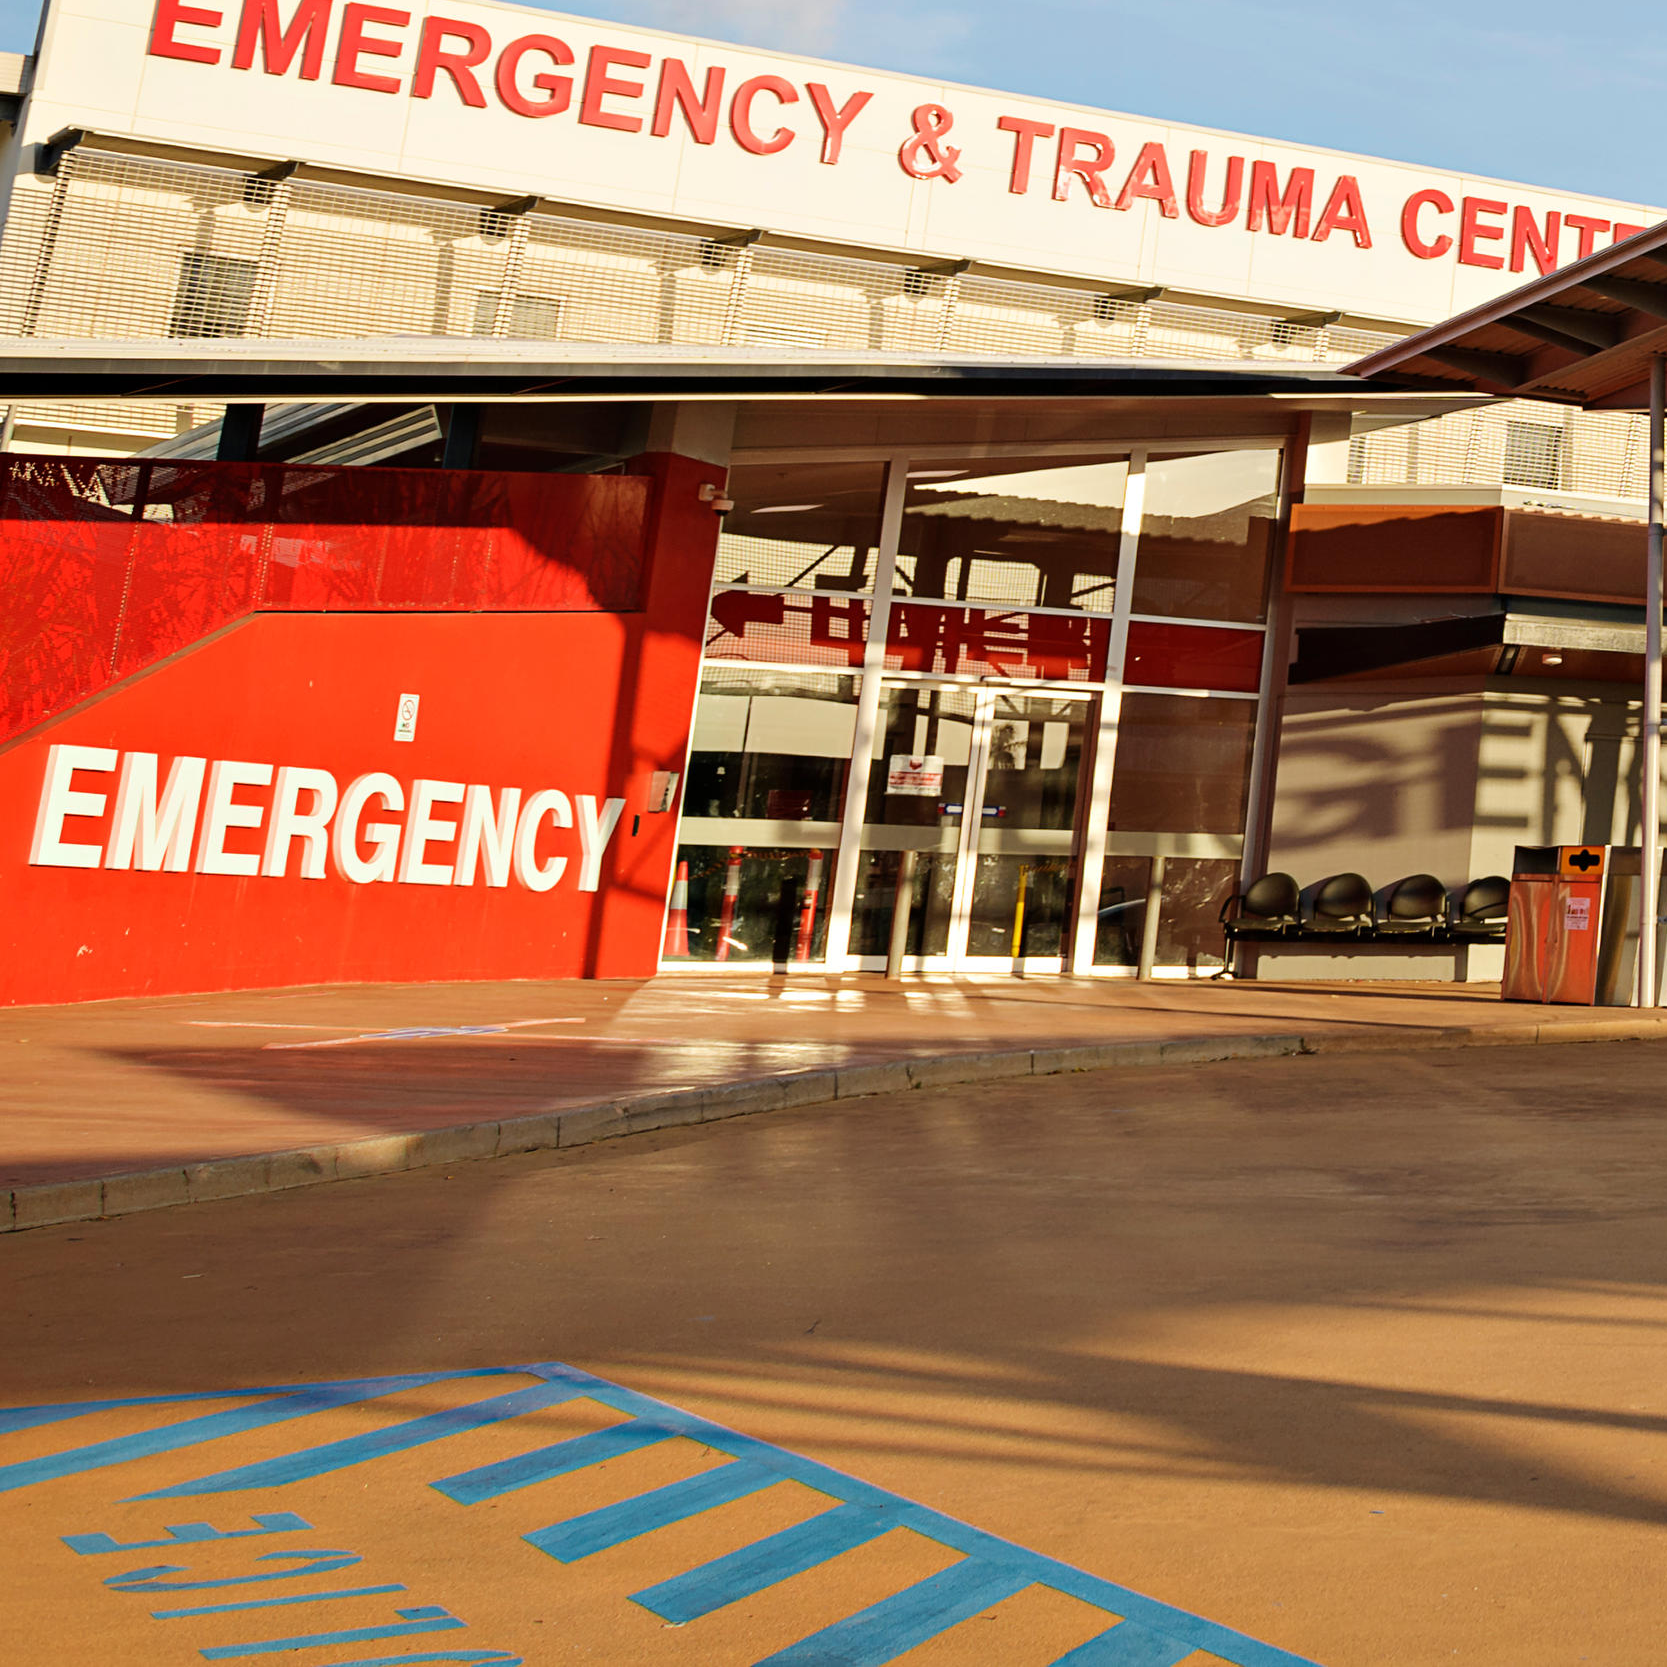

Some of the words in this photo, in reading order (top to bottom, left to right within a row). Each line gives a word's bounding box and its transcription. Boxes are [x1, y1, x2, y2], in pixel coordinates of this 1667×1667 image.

[898, 102, 963, 185] &
[997, 115, 1373, 250] TRAUMA
[1401, 188, 1648, 276] CENT
[29, 744, 626, 893] EMERGENCY
